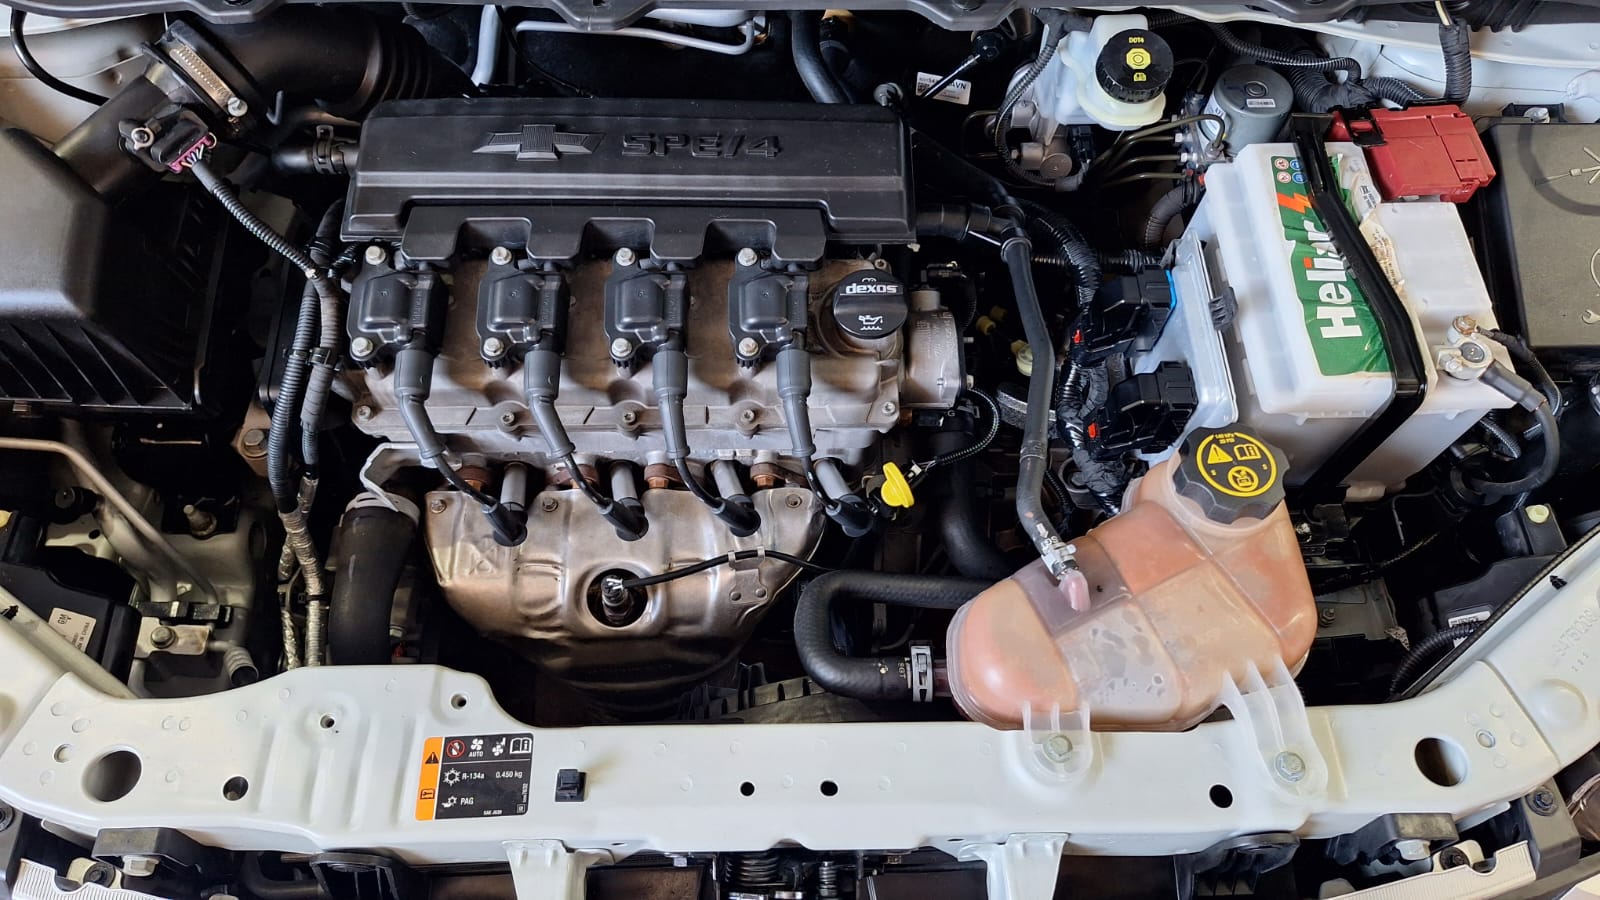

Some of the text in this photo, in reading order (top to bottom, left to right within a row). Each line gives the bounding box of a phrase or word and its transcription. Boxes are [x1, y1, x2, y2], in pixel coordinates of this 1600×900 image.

[1128, 36, 1145, 44] DOT4
[622, 132, 780, 157] SPE/4
[845, 283, 899, 294] dexos
[57, 613, 69, 625] GM
[468, 750, 484, 758] AUTO
[462, 770, 523, 780] R-134a 0.450 kg
[460, 796, 475, 806] PAG
